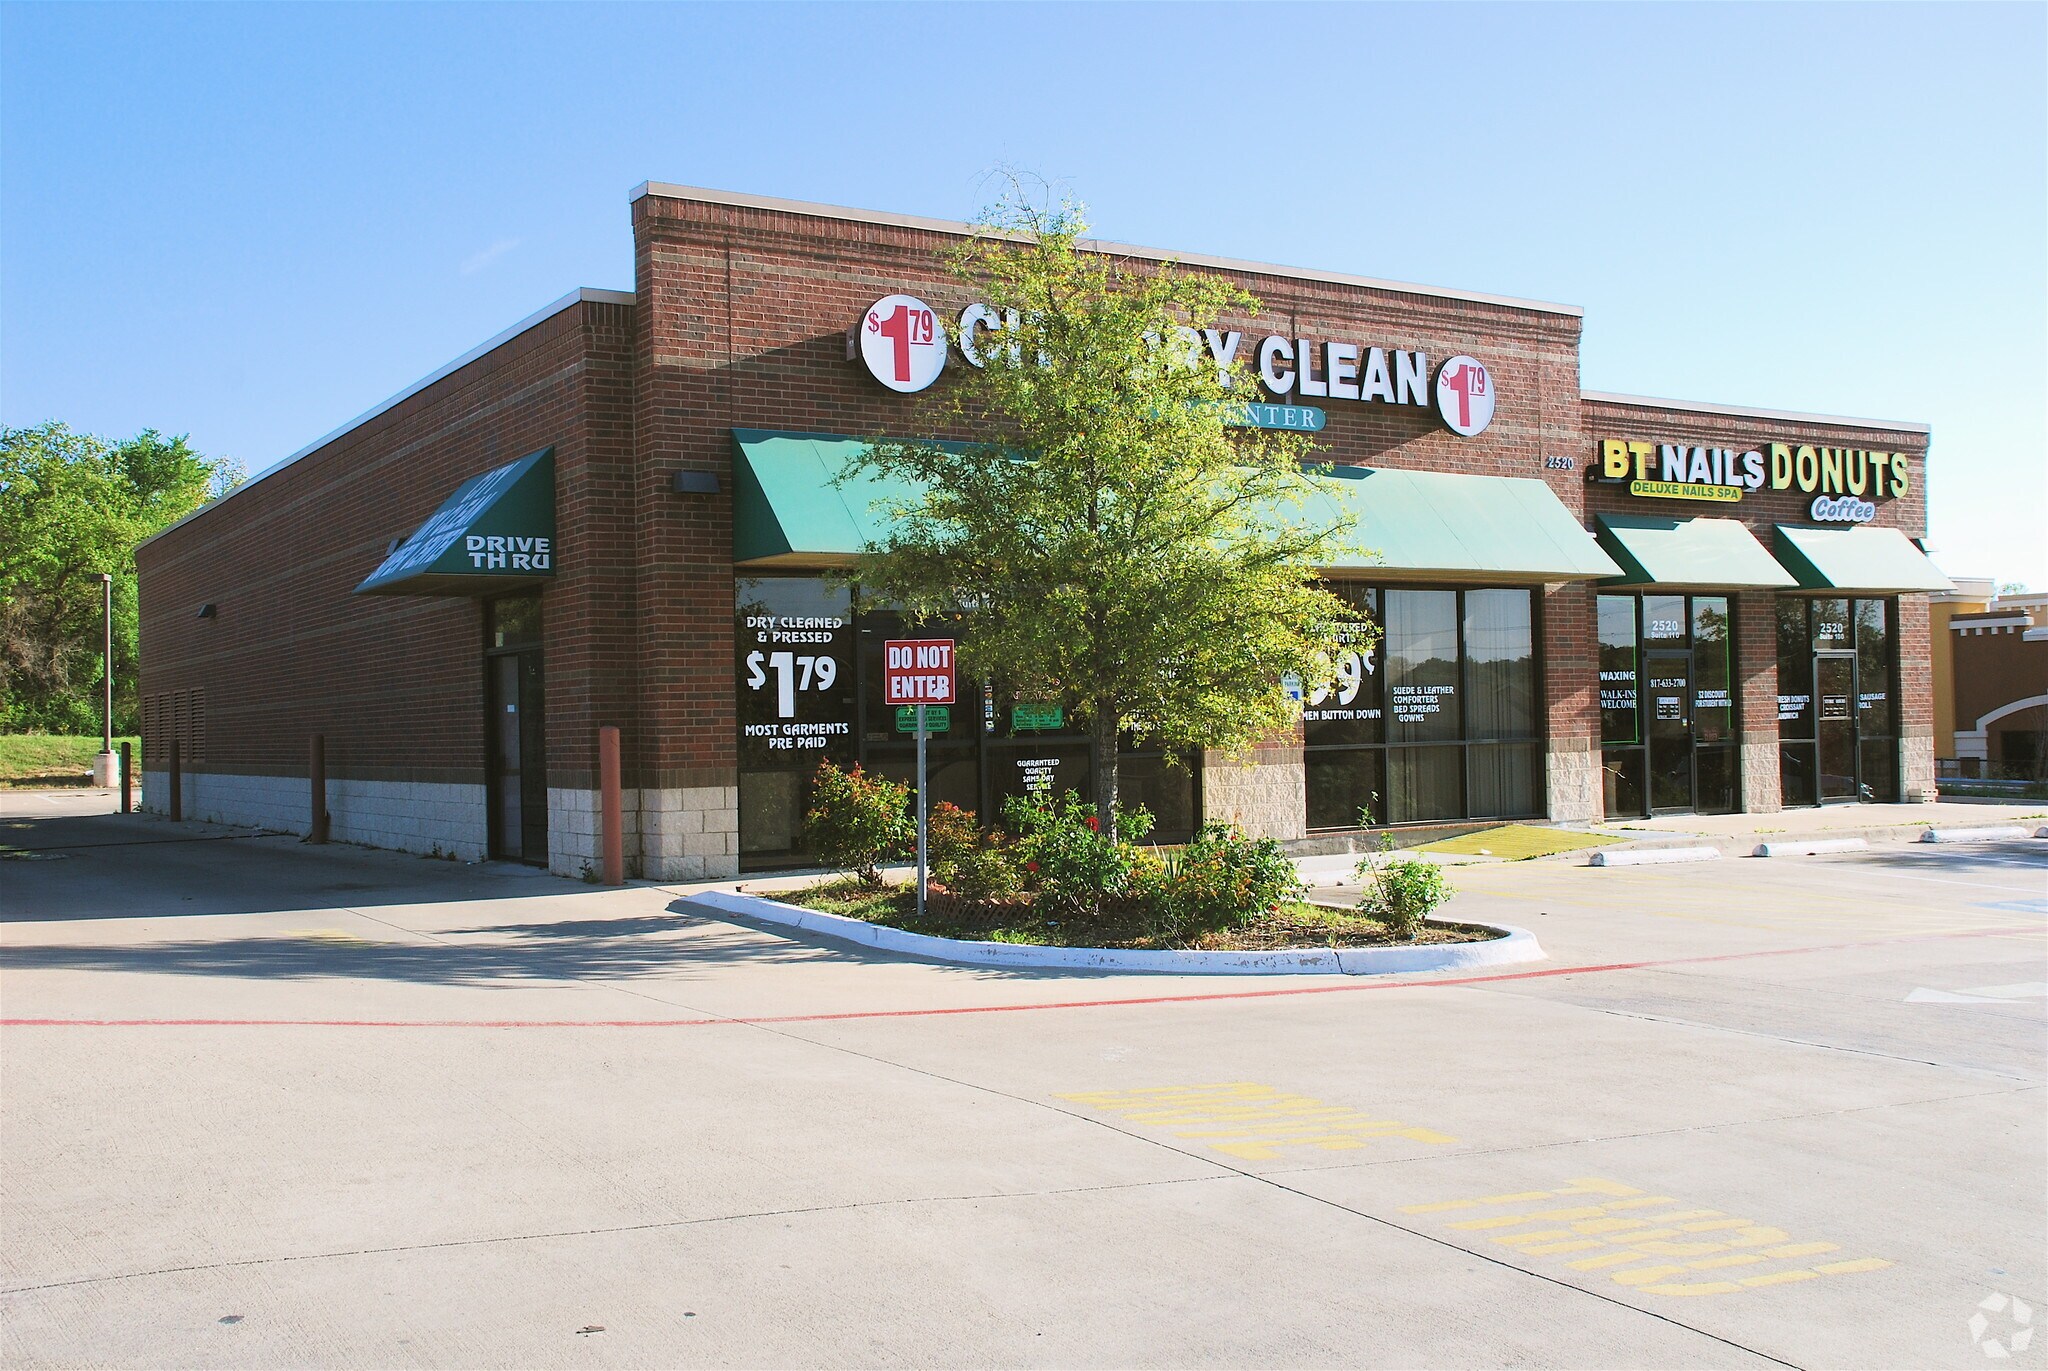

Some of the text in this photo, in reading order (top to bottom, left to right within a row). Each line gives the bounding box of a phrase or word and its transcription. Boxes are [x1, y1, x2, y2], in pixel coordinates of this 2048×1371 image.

[1260, 335, 1429, 406] CLEAN
[1547, 456, 1574, 470] 2520
[1604, 439, 1766, 489] BT NAILS
[1772, 443, 1910, 498] DONUTS
[1633, 482, 1738, 499] DELUXE NAILS SPA
[1813, 497, 1874, 522] Coffee
[466, 535, 550, 553] DRIVE
[747, 616, 843, 629] DRY CLEANED
[1652, 620, 1678, 630] 2520
[1820, 623, 1843, 633] 2520
[757, 631, 833, 643] & PRESSED
[889, 645, 950, 669] DO NOT
[1600, 671, 1636, 681] WAXING
[891, 675, 950, 699] ENTER
[1424, 686, 1454, 694] LEATHER
[1393, 695, 1439, 704] COMFORTERS
[1600, 690, 1637, 698] WALK-INS
[1393, 704, 1440, 713] BED SPREADS
[1600, 700, 1637, 709] WELCOME
[1321, 710, 1354, 720] BUTTON
[1356, 709, 1381, 719] DOWN
[1398, 714, 1424, 722] GOWNS
[745, 723, 849, 736] MOST GARMENTS
[769, 736, 827, 750] PRE PAID
[1016, 759, 1060, 767] GUARANTEED
